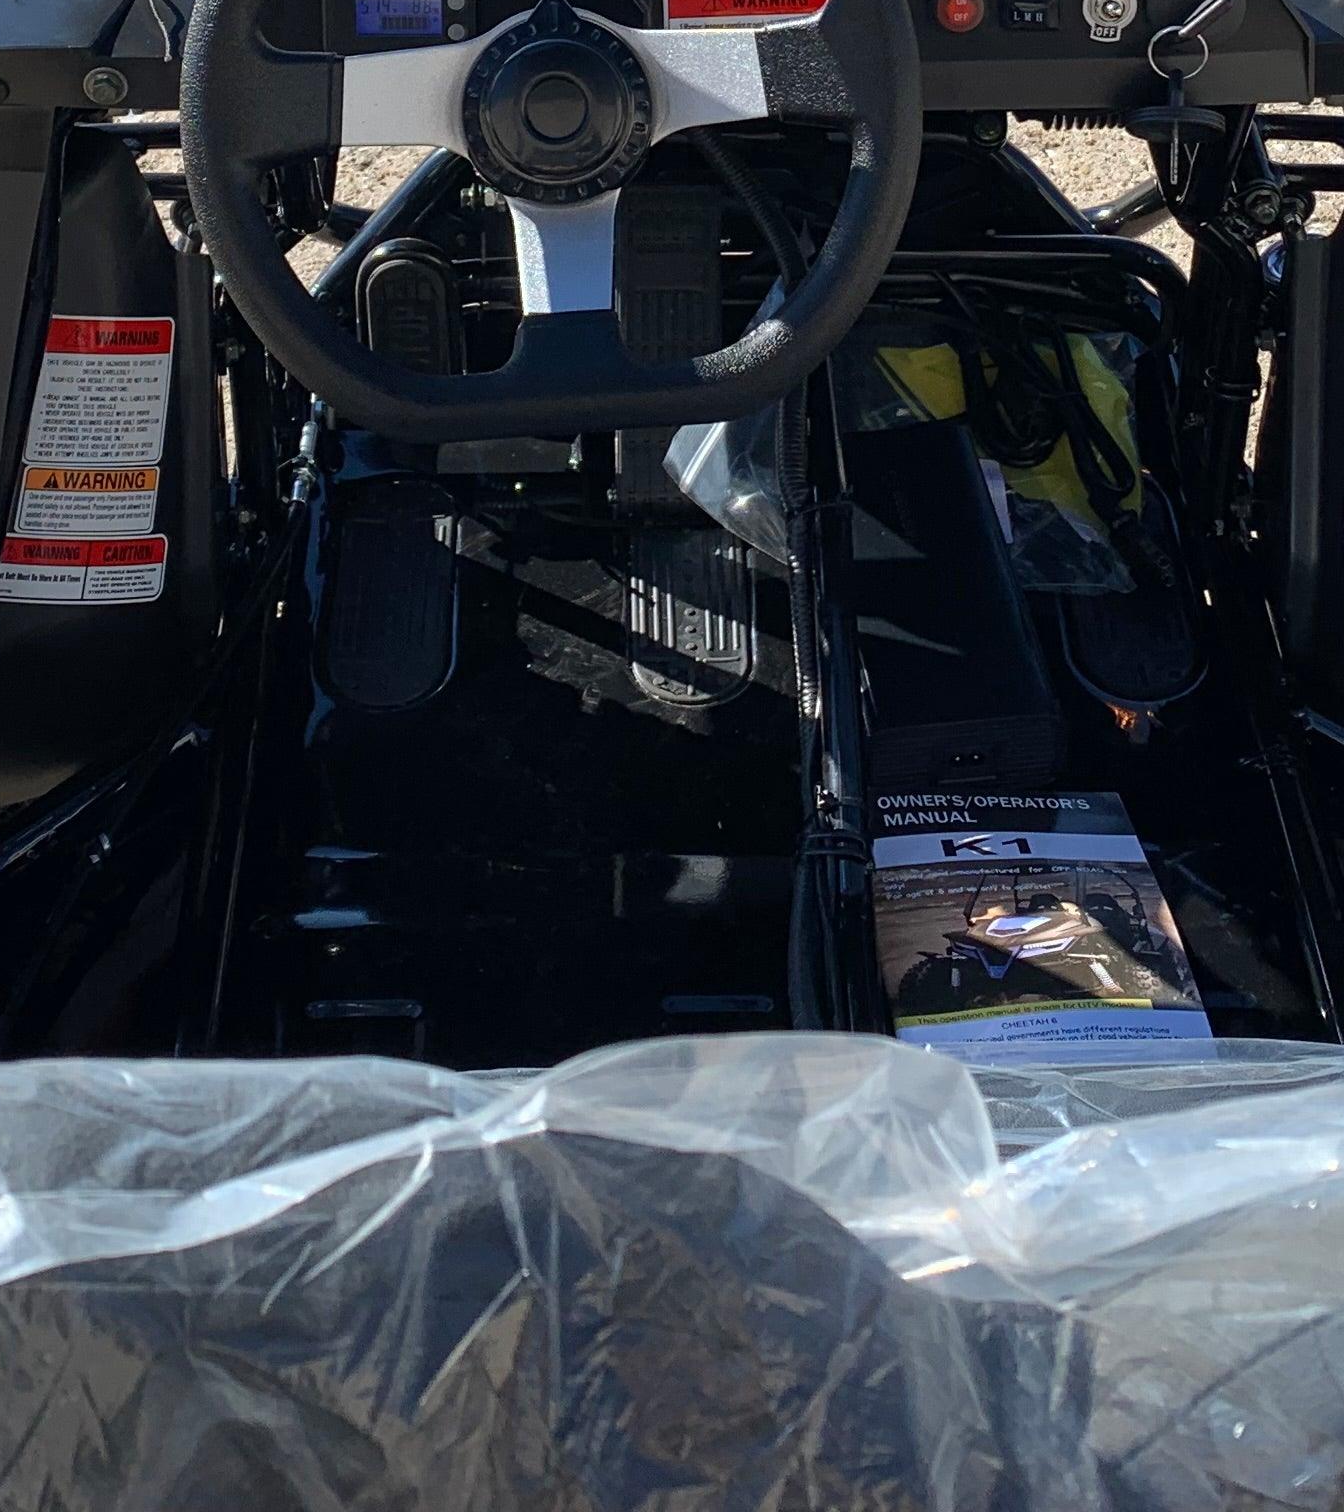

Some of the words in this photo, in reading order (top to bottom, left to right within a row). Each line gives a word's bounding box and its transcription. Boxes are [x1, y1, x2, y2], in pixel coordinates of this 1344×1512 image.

[954, 13, 969, 22] OFF
[1095, 26, 1116, 37] OFF
[94, 331, 161, 347] WARNING
[63, 471, 146, 490] WARNING
[23, 544, 80, 560] WARNING
[877, 794, 1090, 810] OWNER'S/OPERATOR'S
[883, 811, 978, 827] MANUAL
[940, 834, 1033, 857] K1
